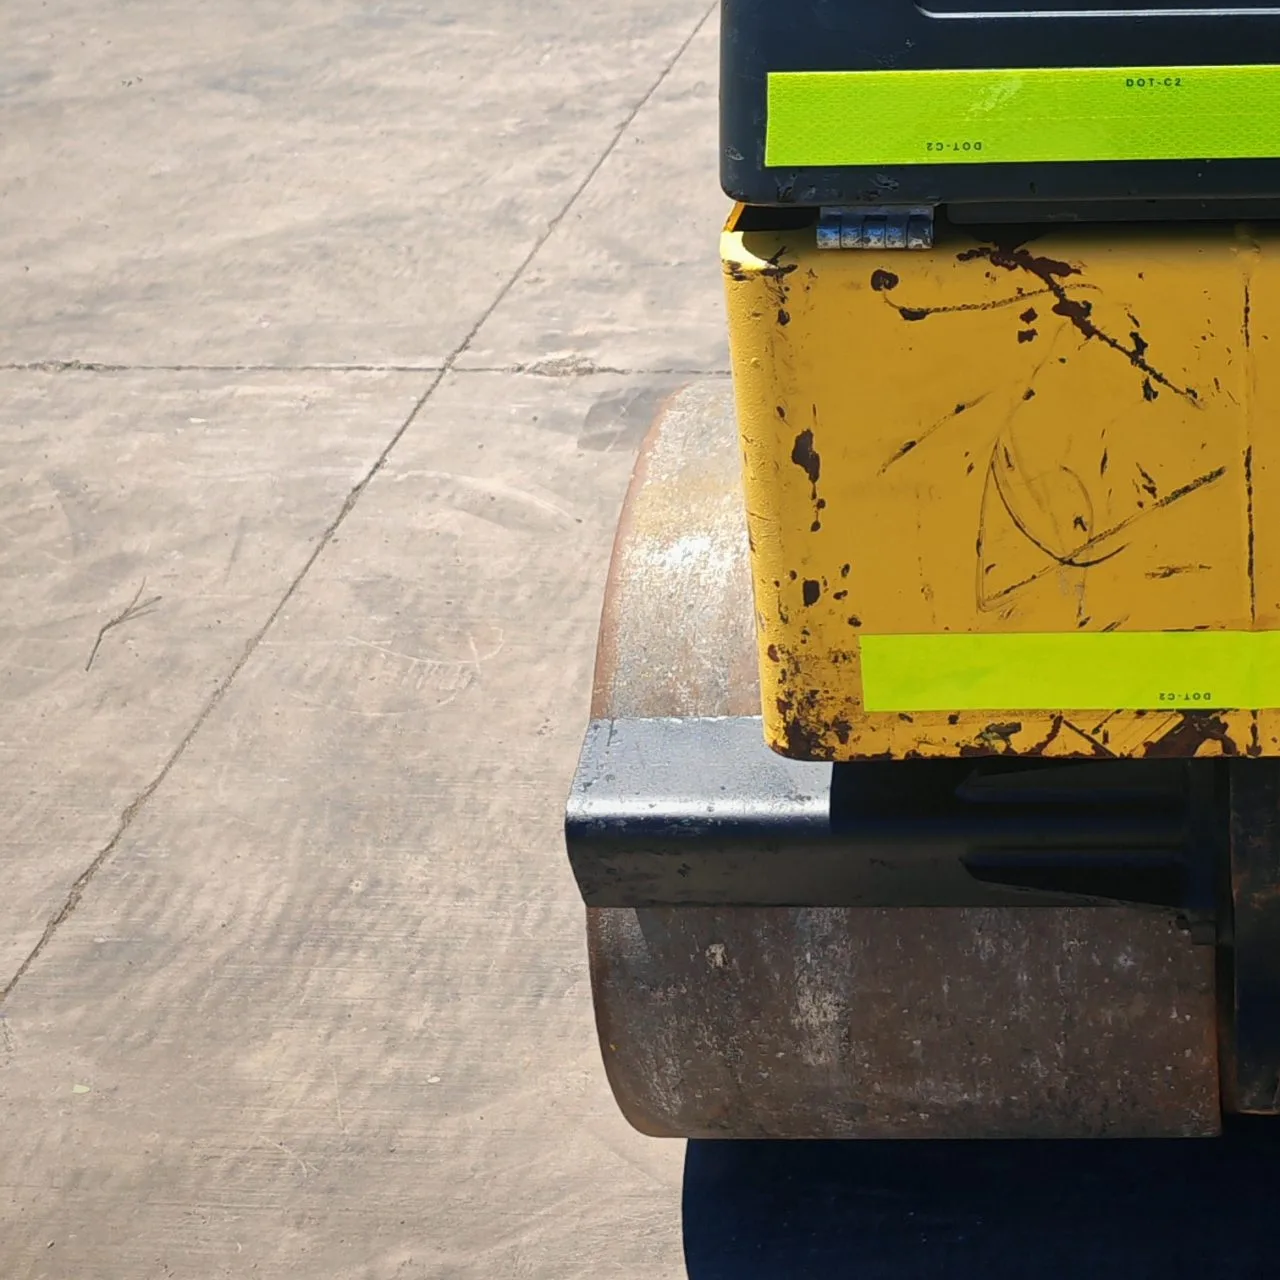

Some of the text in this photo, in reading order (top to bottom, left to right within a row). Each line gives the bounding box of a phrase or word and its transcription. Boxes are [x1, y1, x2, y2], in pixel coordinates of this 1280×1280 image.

[1126, 78, 1182, 87] DOT-C2
[927, 142, 982, 151] DOT-C2
[1159, 692, 1211, 701] DOT-C2
